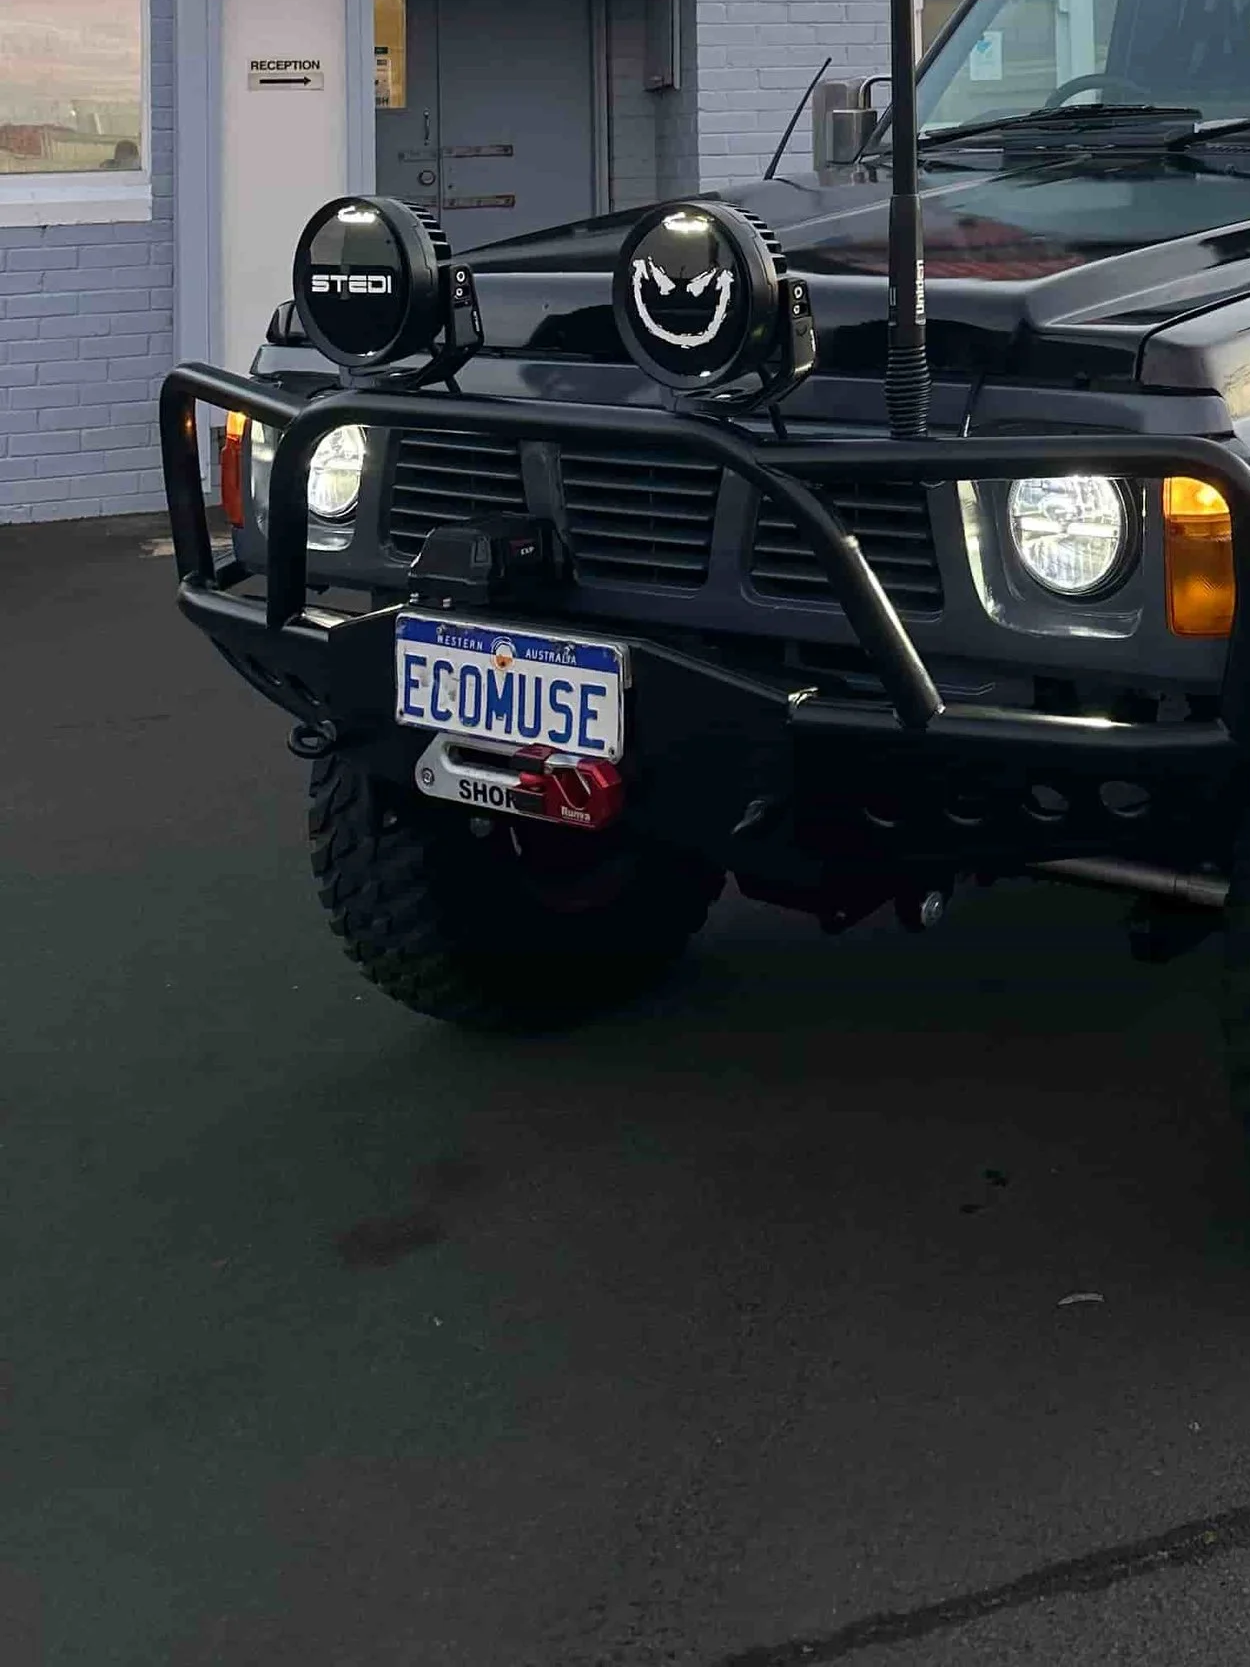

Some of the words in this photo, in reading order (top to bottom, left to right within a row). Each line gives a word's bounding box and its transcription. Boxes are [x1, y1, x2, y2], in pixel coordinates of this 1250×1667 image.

[251, 60, 320, 71] RECEPTION
[311, 274, 392, 294] STEDI
[915, 259, 925, 315] Uniden
[437, 634, 484, 650] WESTERN
[525, 647, 577, 665] AUSTRALIA
[404, 653, 607, 751] ECOMUSE
